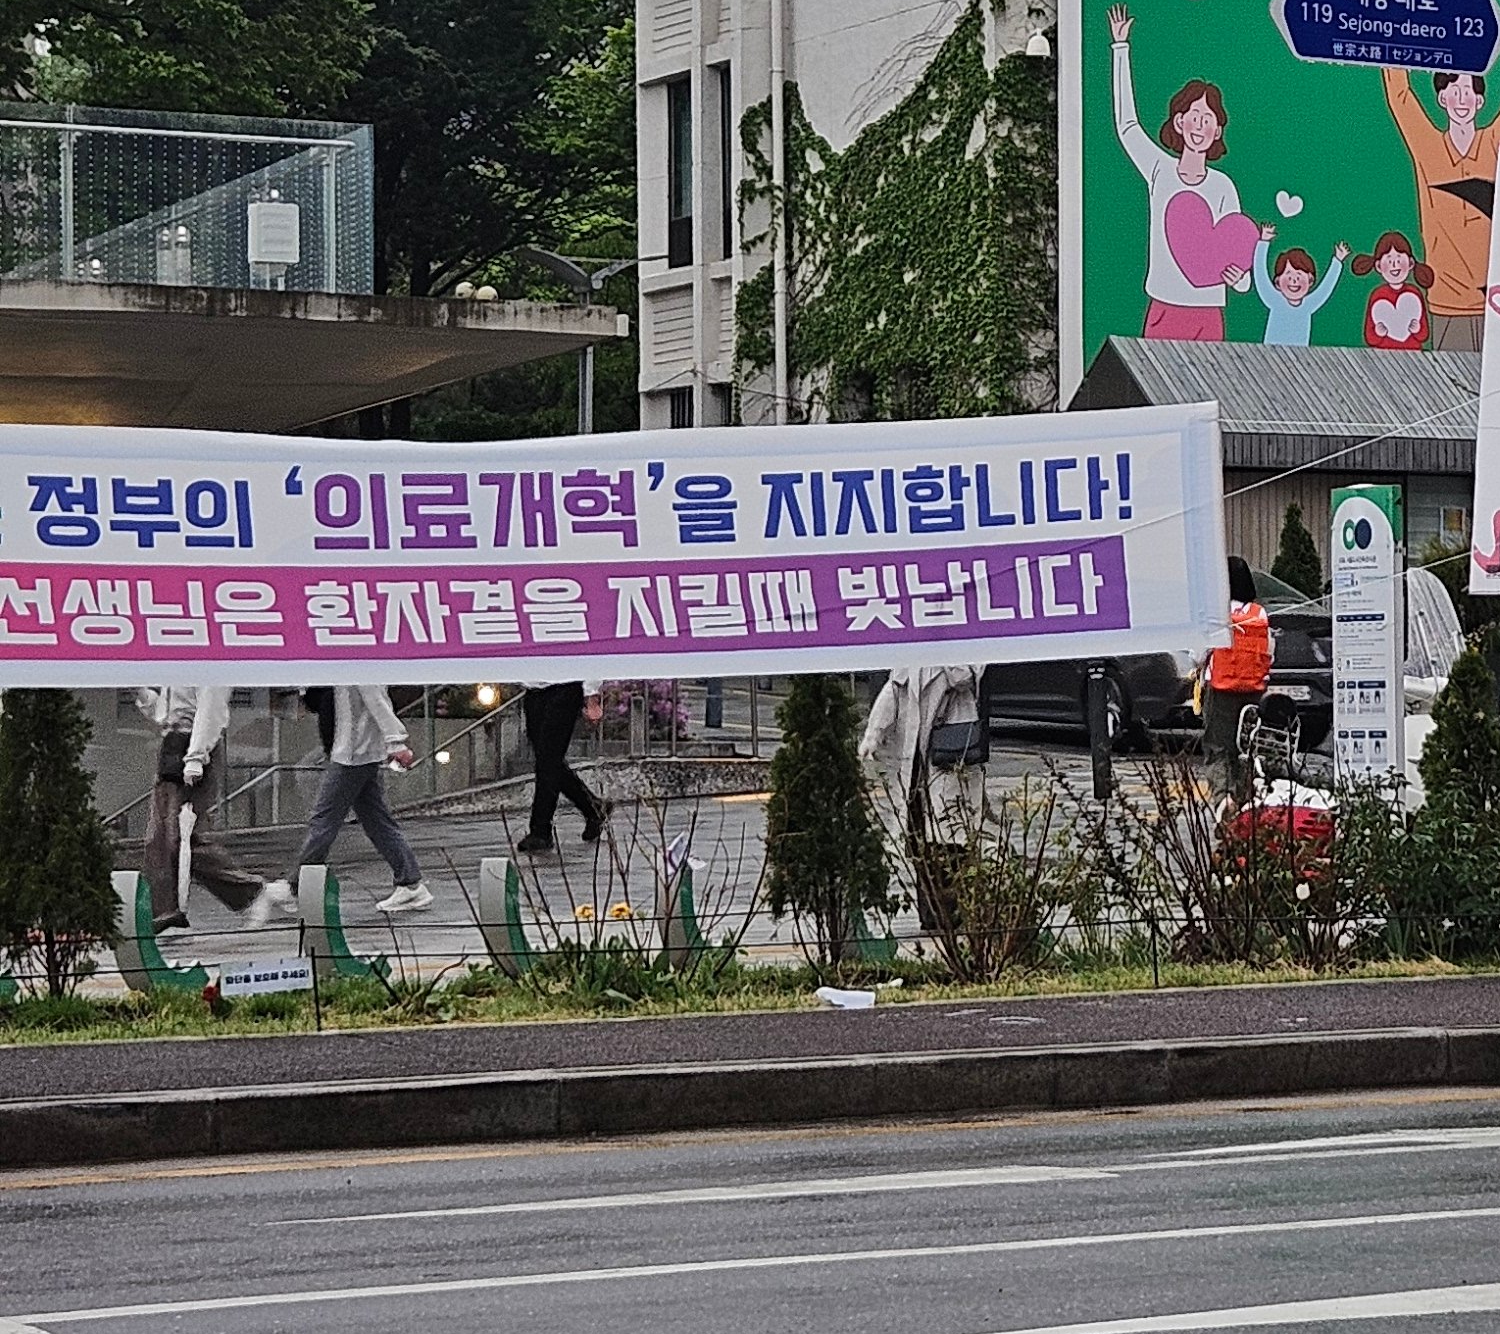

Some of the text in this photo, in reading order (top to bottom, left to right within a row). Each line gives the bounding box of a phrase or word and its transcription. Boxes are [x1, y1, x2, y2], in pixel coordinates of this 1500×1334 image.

[1300, 1, 1485, 40] 119 Sejong-daero 123
[1332, 42, 1383, 60] 世宗大路
[27, 474, 254, 549] 정부의
[762, 452, 1132, 539] 지지합니다!
[0, 552, 1104, 647] 선생님은 환자곁을 지킬때 빛납니다
